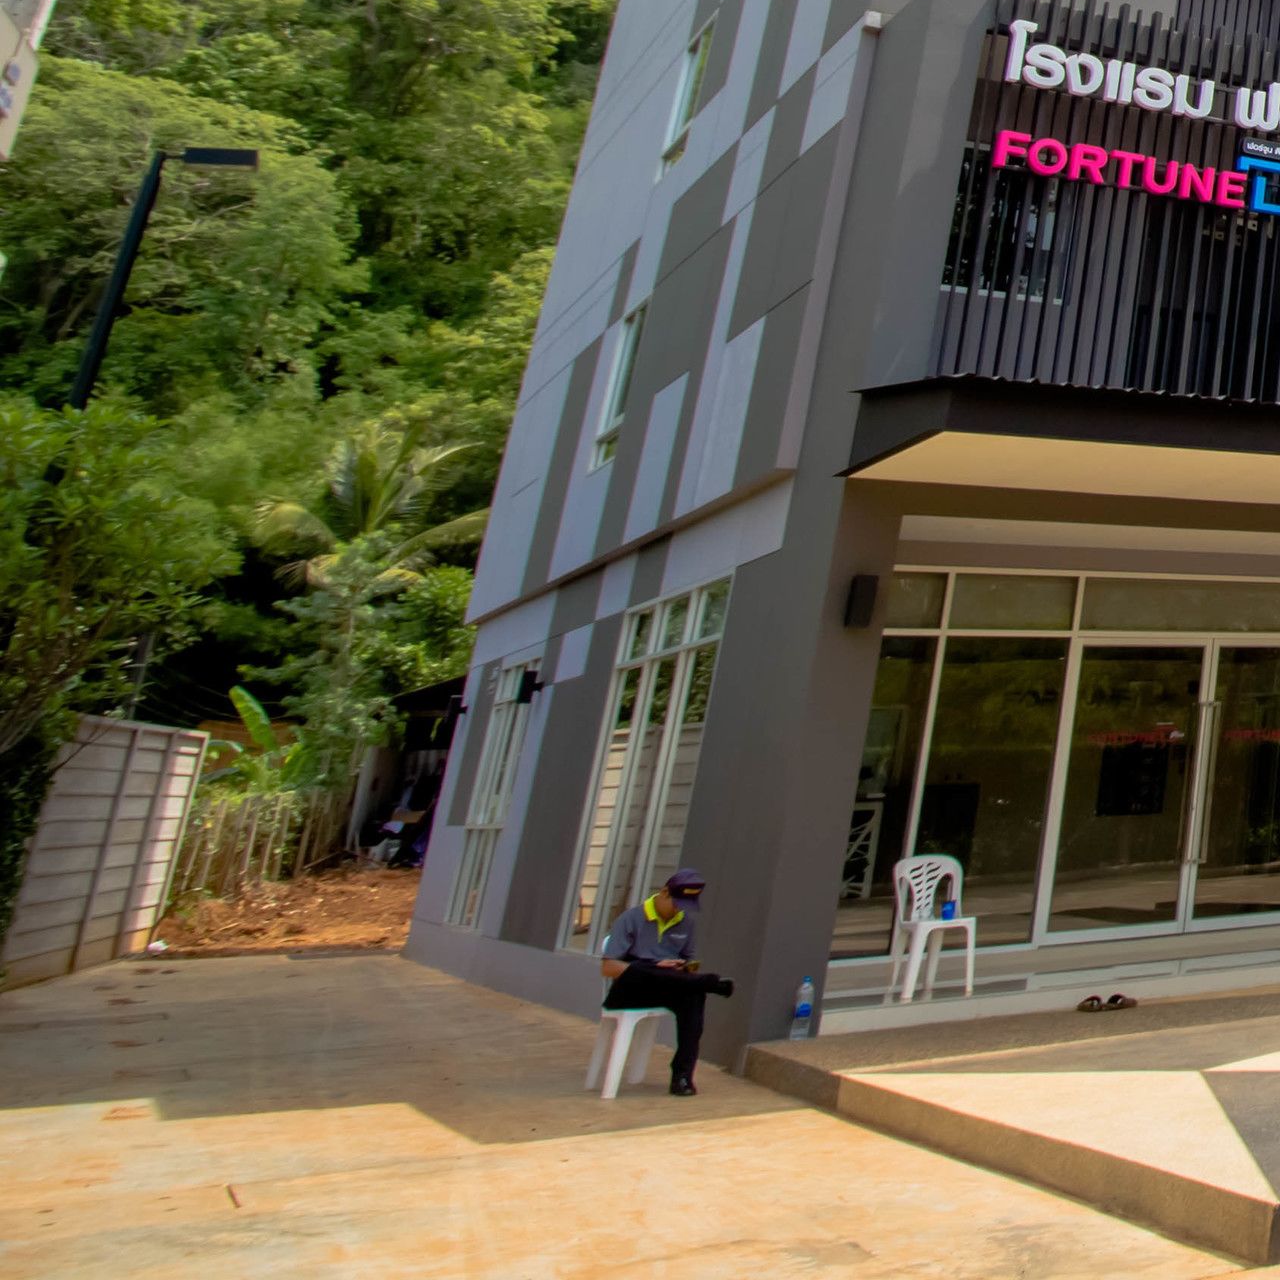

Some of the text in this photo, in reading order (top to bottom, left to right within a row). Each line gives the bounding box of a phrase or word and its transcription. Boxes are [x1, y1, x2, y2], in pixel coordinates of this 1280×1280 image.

[1005, 20, 1215, 119] โรงแรม
[992, 130, 1248, 208] FORTUNE
